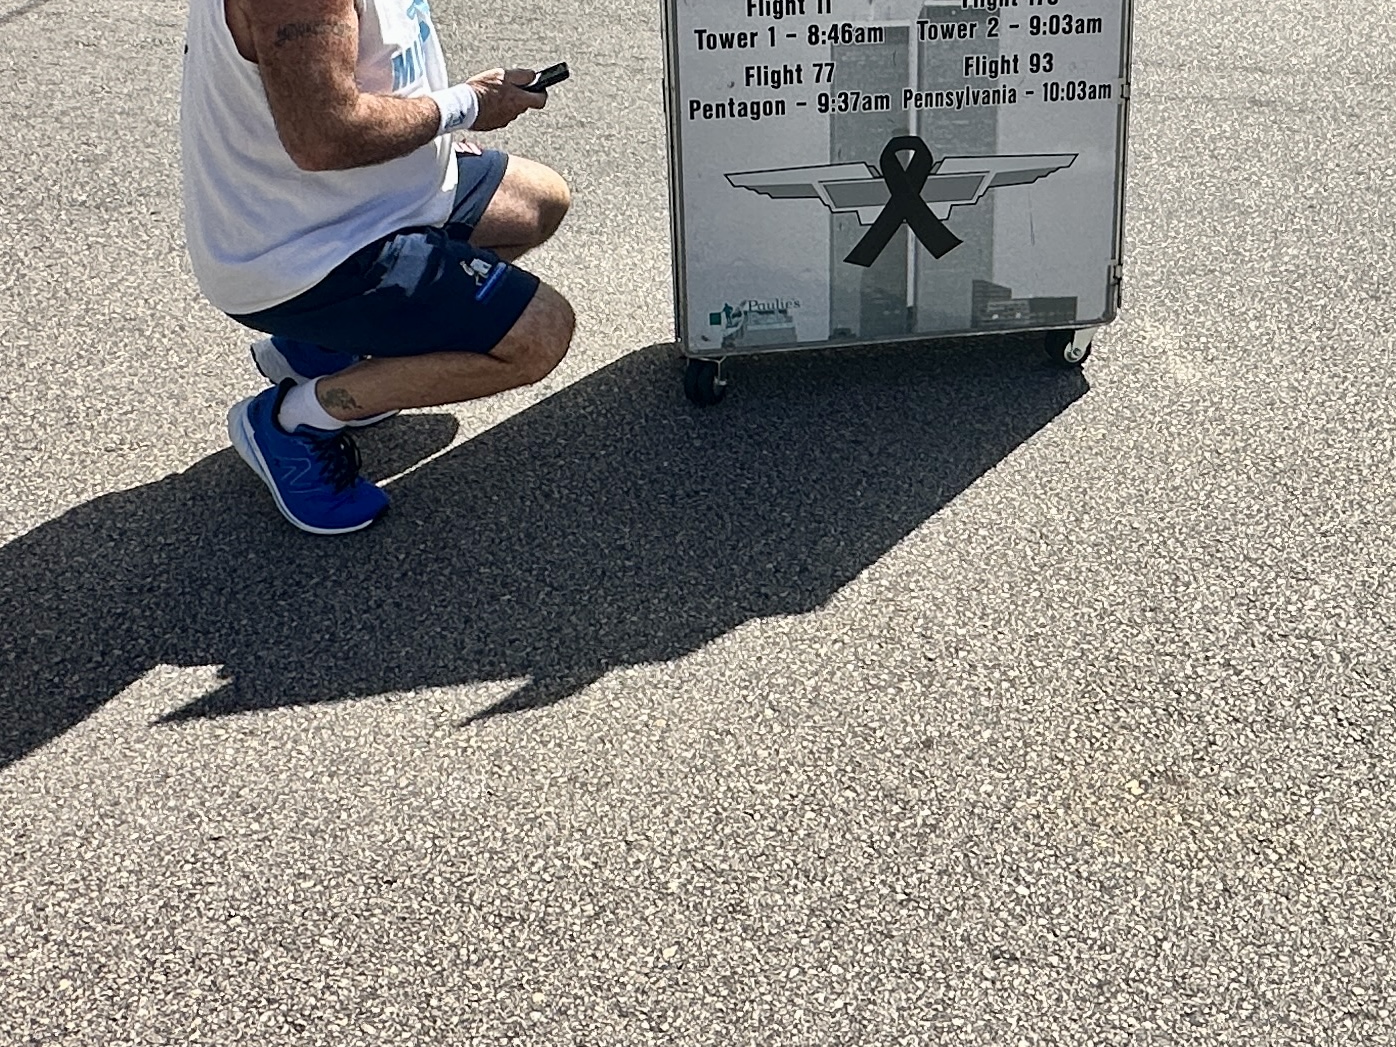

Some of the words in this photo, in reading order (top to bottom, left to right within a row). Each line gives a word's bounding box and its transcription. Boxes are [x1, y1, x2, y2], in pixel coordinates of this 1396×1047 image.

[693, 28, 759, 51] Tower
[767, 25, 776, 48] 1
[807, 22, 885, 47] 8:46am
[916, 19, 978, 41] Tower
[987, 16, 999, 38] 2
[1029, 13, 1102, 36] 9:03am
[744, 63, 803, 90] Flight
[812, 62, 835, 84] 77
[964, 54, 1019, 80] Flight
[1029, 52, 1054, 74] 93
[689, 97, 786, 122] Pentagon
[817, 91, 890, 115] 9:37am
[903, 82, 1017, 110] Pennsylvania
[1042, 80, 1112, 102] 10:03am
[748, 298, 801, 311] Paulie's
